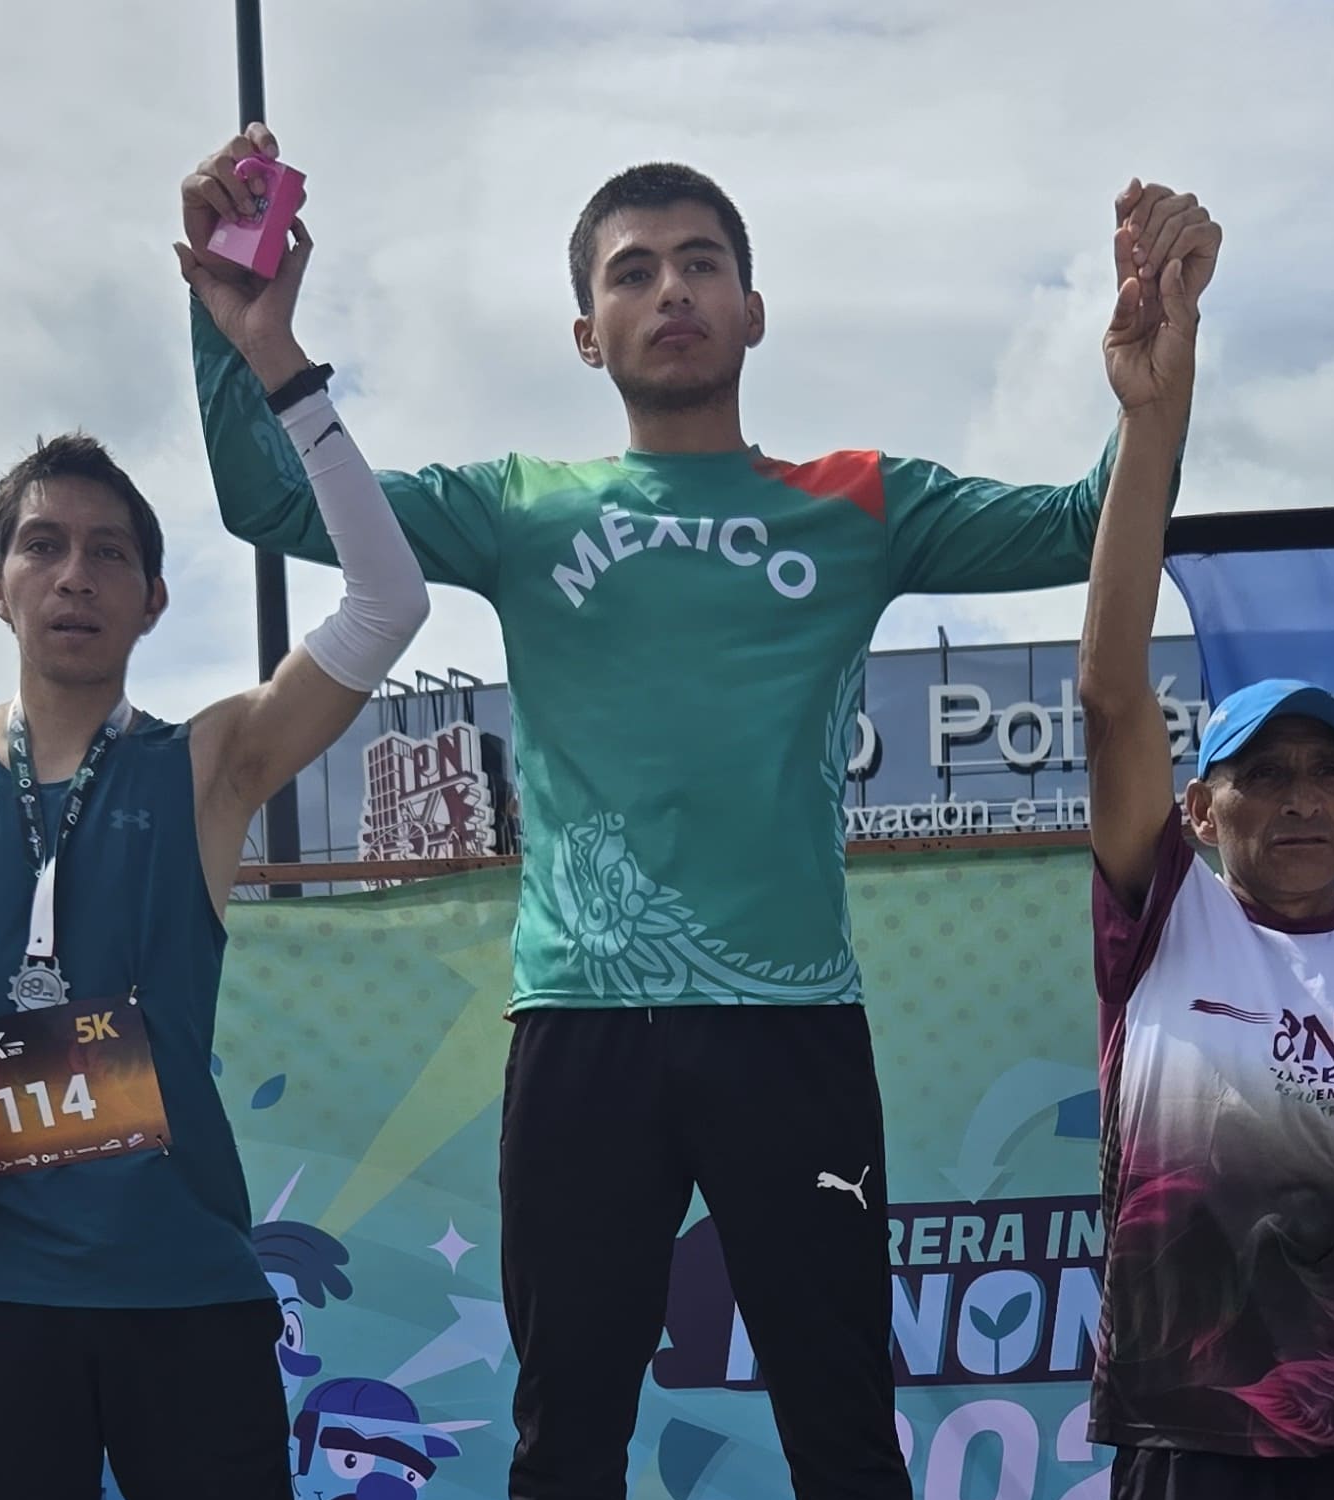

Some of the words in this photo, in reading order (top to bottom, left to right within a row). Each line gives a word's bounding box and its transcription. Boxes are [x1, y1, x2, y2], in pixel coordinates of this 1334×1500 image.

[552, 502, 817, 609] MÉXICO
[1011, 797, 1037, 827] e
[75, 1011, 120, 1044] 5K
